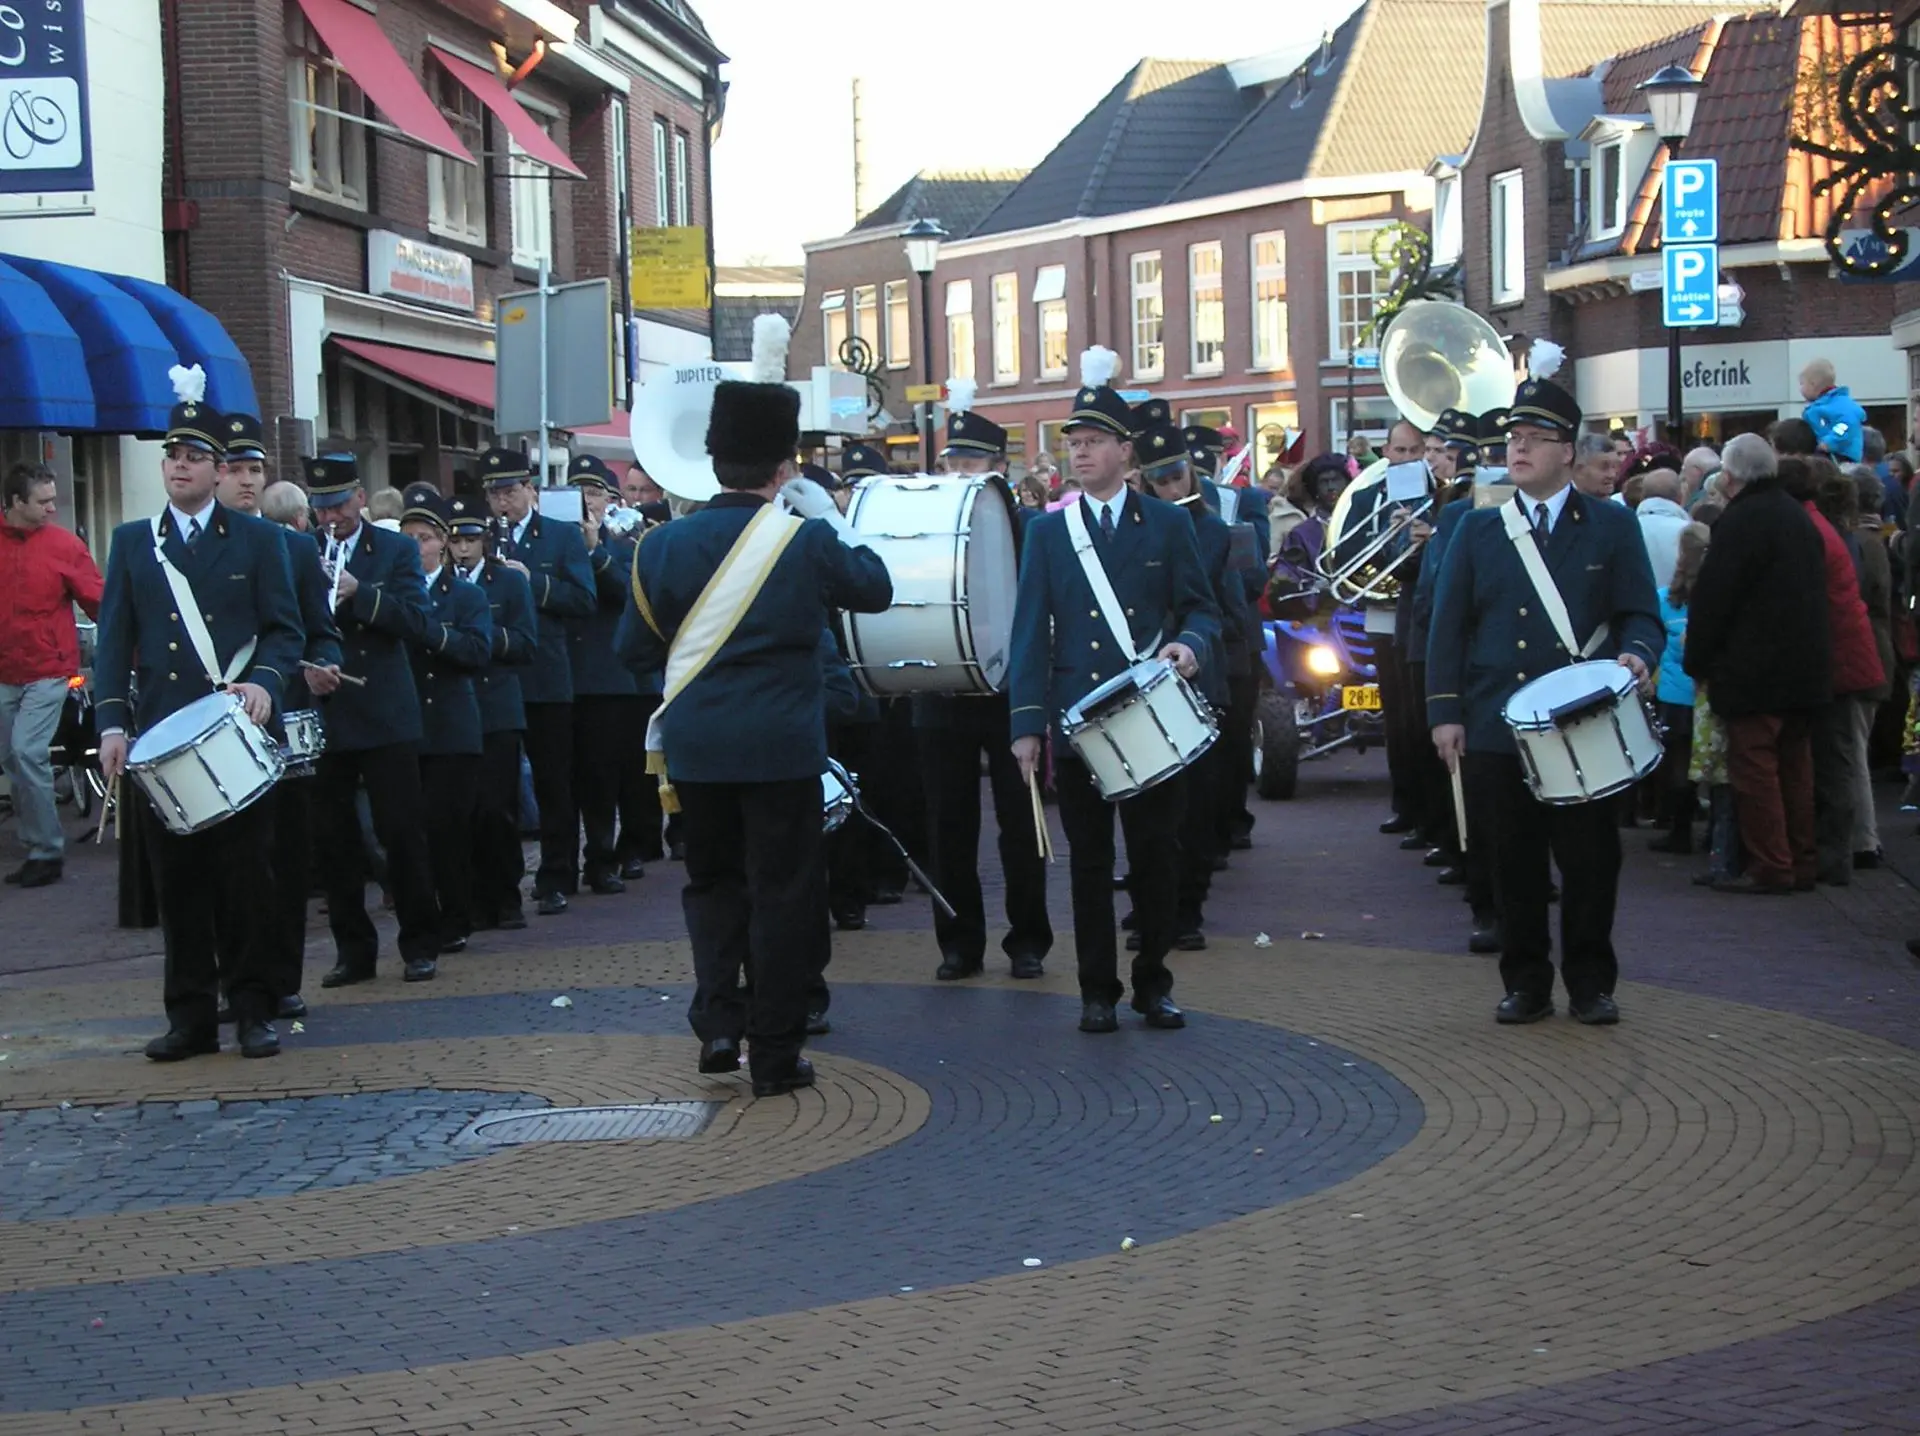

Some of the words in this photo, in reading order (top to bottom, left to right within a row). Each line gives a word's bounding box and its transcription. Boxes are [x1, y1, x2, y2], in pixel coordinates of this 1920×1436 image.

[1674, 166, 1705, 208] P
[1675, 208, 1705, 219] route
[1674, 250, 1706, 292] P
[1671, 292, 1711, 303] station
[674, 367, 721, 384] JUPITER
[1680, 359, 1751, 388] eferink
